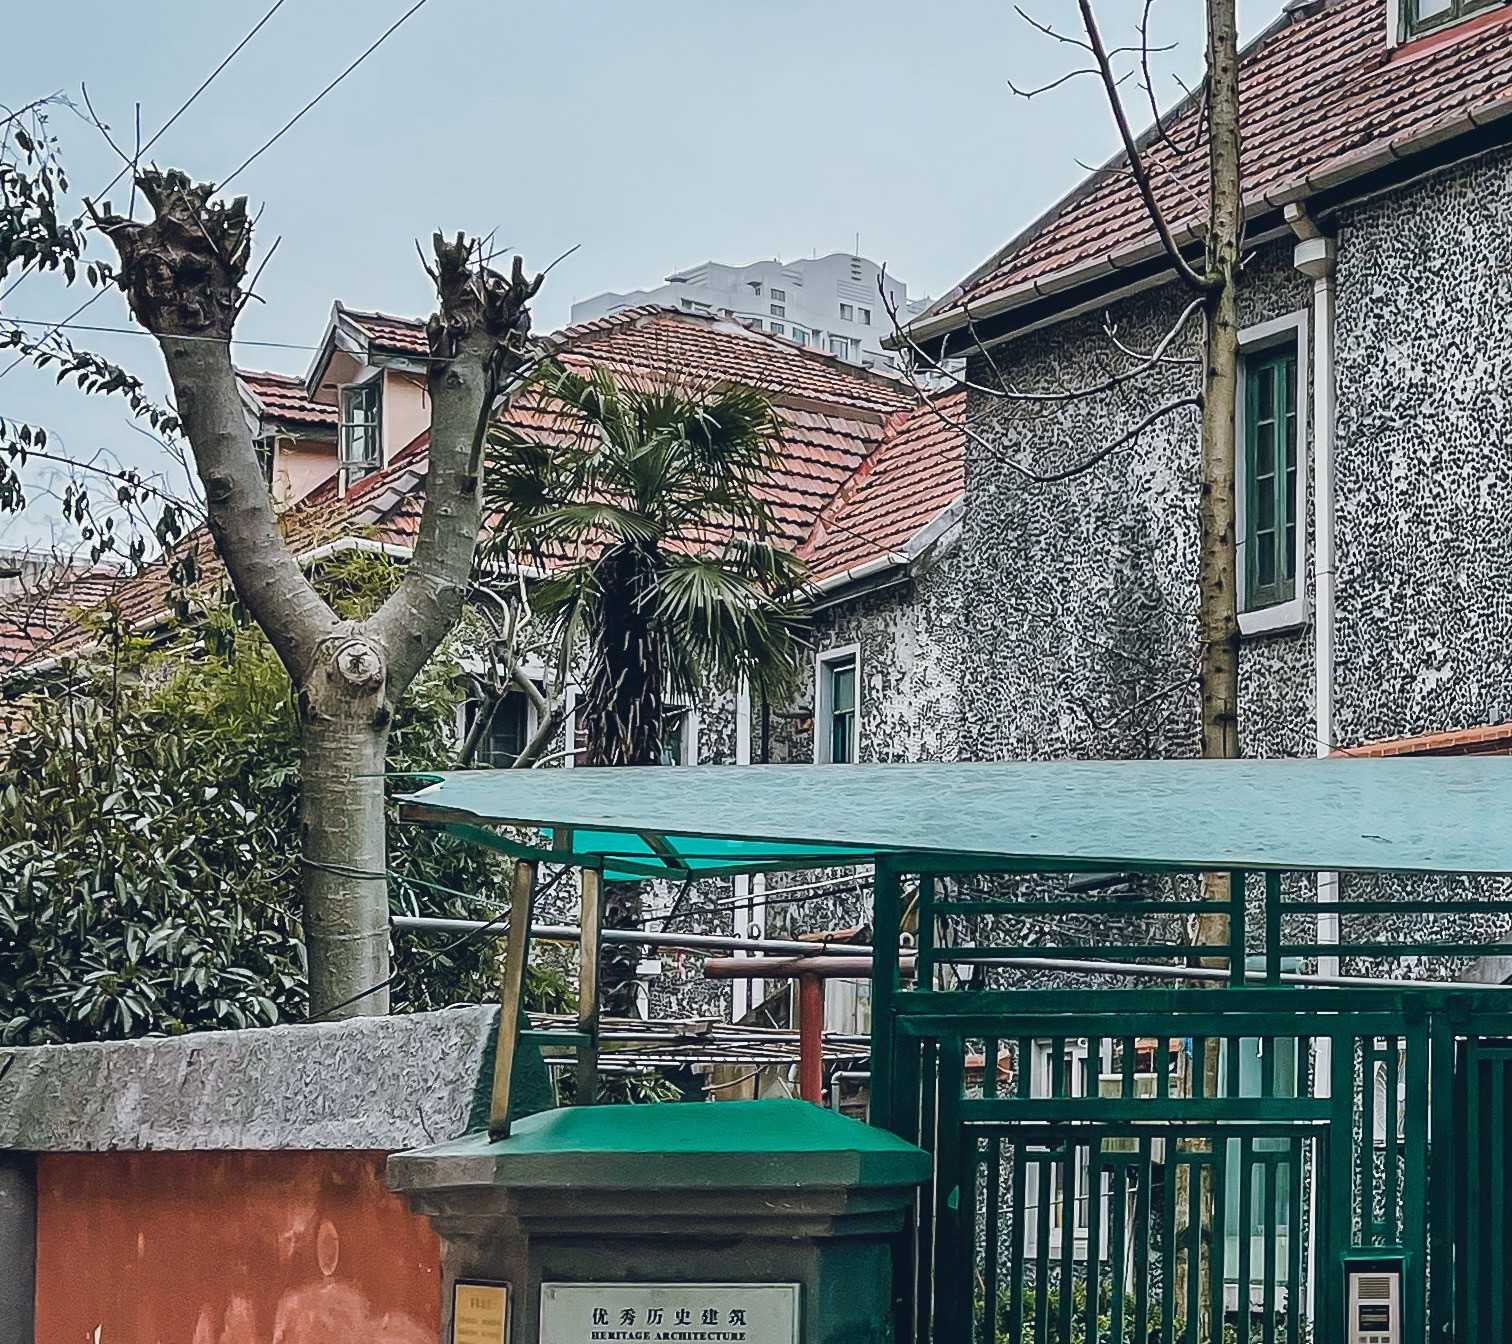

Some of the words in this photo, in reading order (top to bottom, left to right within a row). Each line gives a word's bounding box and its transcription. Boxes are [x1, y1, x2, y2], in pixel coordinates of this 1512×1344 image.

[592, 1307, 748, 1326] 优秀历史建筑
[591, 1331, 651, 1341] HERITAGE
[654, 1331, 747, 1342] ARCHITECTURE
